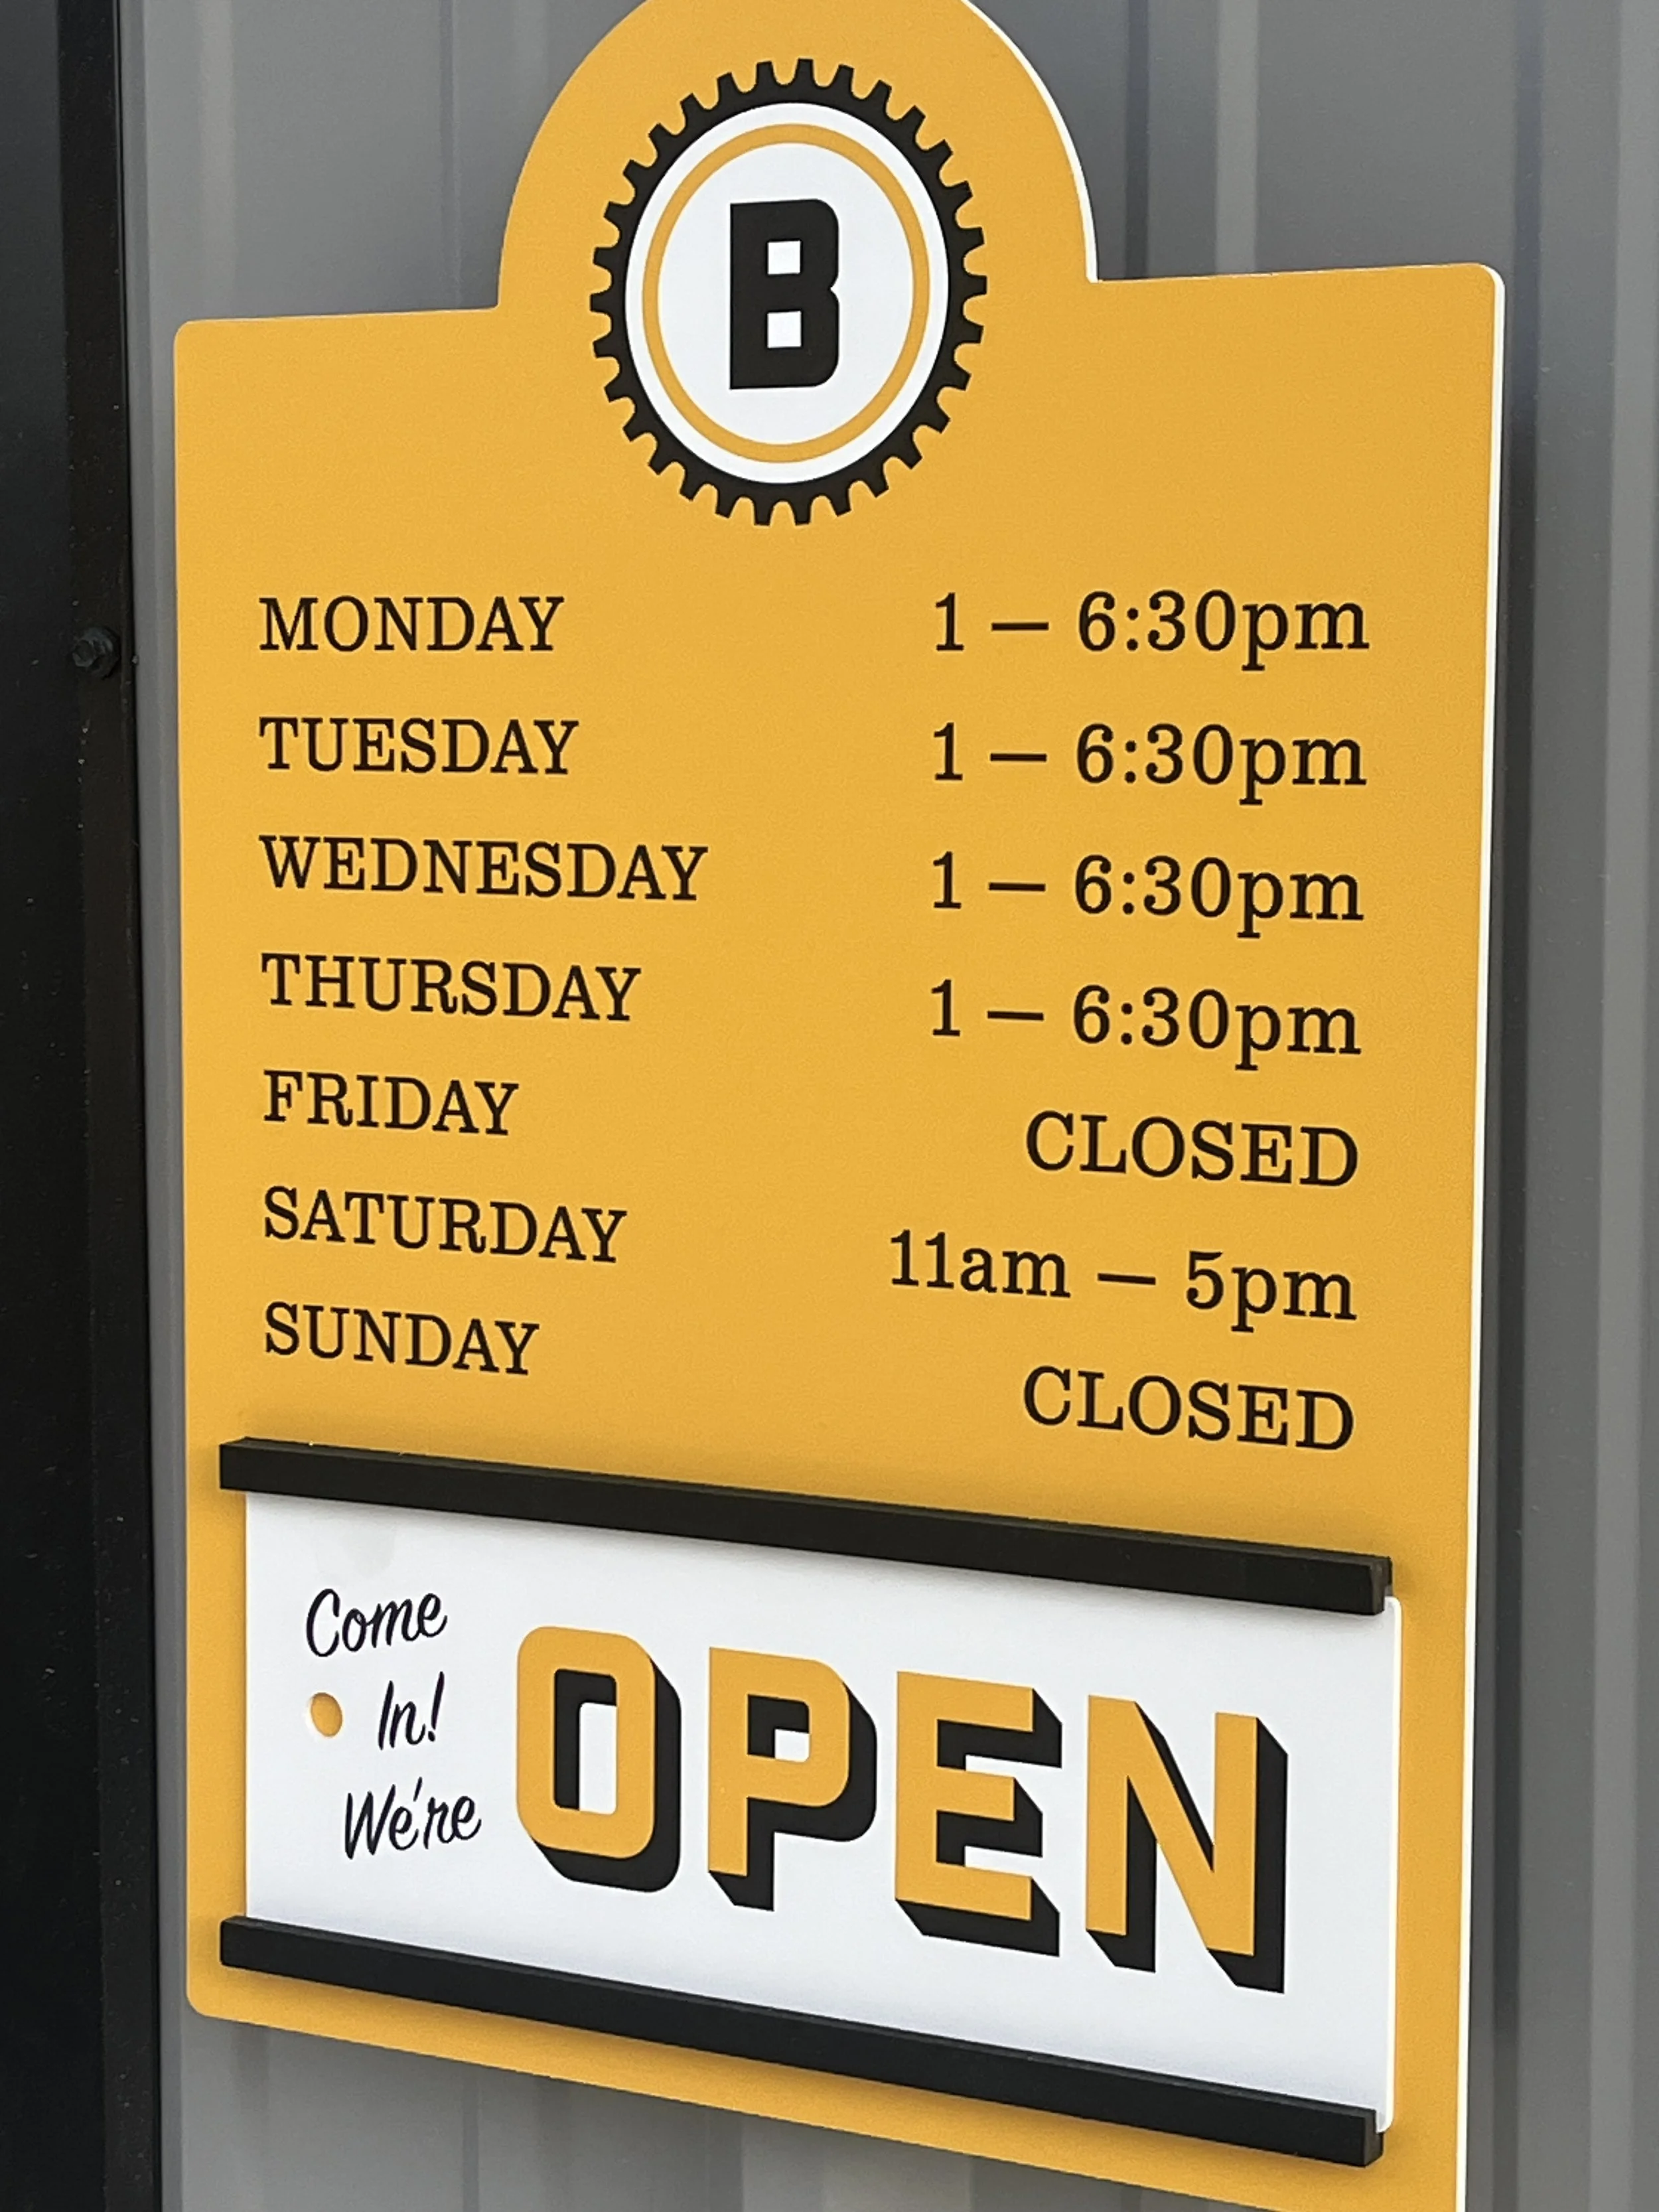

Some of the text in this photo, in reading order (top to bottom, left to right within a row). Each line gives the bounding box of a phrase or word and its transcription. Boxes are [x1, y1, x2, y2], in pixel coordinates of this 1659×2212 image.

[729, 200, 839, 390] B
[259, 595, 565, 652] MONDAY
[935, 592, 964, 652] 1
[1079, 589, 1370, 672] 6:30pm
[259, 716, 579, 775] TUESDAY
[934, 722, 963, 781] 1
[1077, 723, 1367, 806] 6:30pm
[258, 835, 709, 901] WEDNESDAY
[932, 851, 962, 909] 1
[1075, 854, 1364, 939] 6:30pm
[261, 952, 642, 1022] THURSDAY
[931, 979, 961, 1037] 1
[1074, 984, 1362, 1071] 6:30pm
[263, 1069, 1358, 1187] FRIDAY CLOSED
[265, 1185, 627, 1264] SATURDAY
[891, 1229, 1071, 1298] 11am
[1187, 1250, 1357, 1333] 5pm
[265, 1301, 1354, 1450] SUNDAY CLOSED
[306, 1588, 448, 1657] Come
[378, 1671, 445, 1750] In!
[344, 1777, 482, 1860] We're
[515, 1625, 1289, 1994] OPEN
